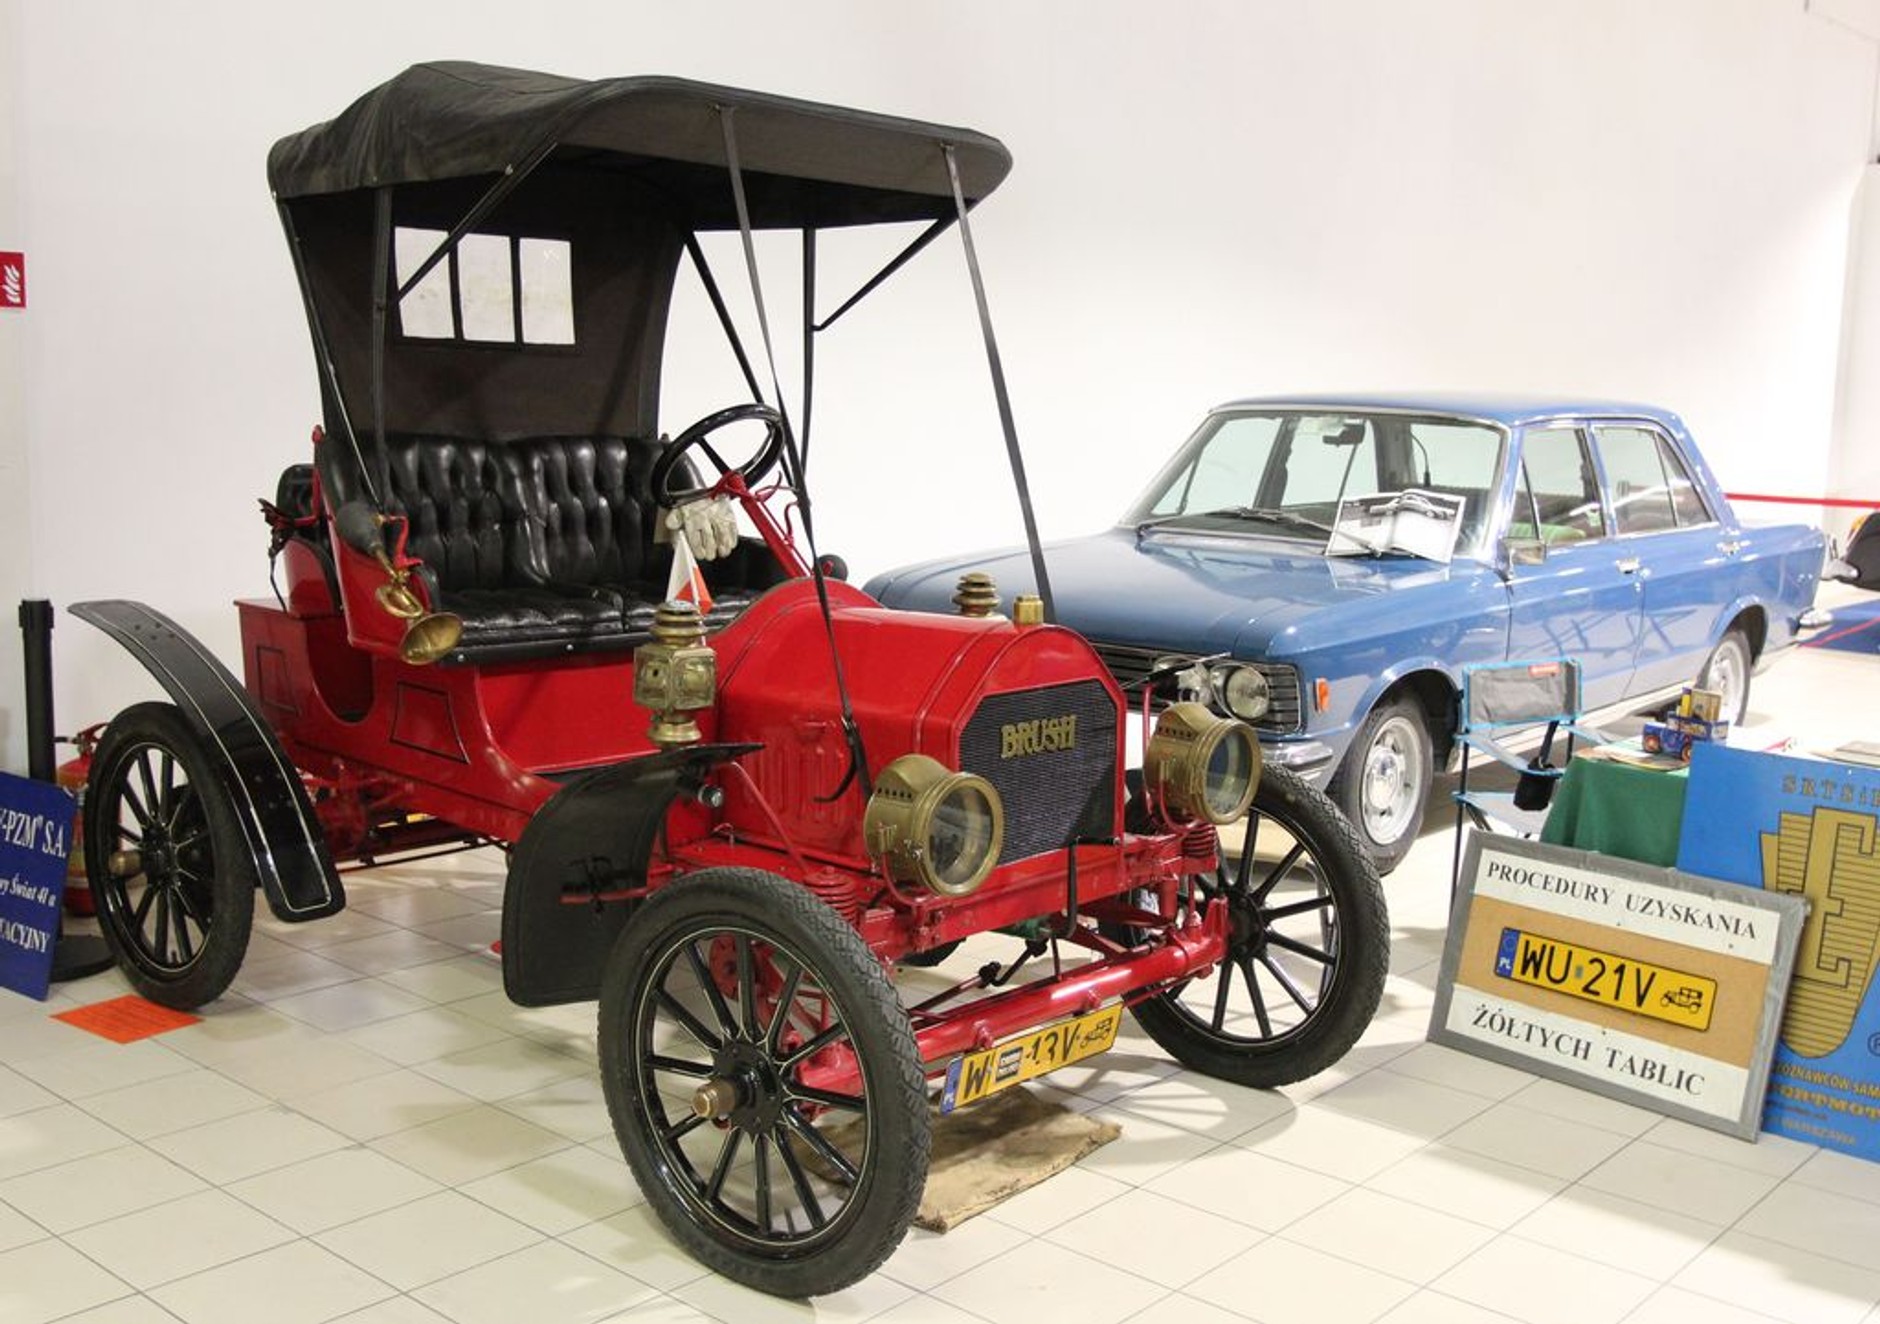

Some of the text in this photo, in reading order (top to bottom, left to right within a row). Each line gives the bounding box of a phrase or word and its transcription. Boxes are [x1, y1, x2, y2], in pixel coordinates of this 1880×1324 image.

[1001, 714, 1077, 758] BRUSH
[1487, 861, 1757, 940] PROCEDURY UZYSKANIA
[1520, 939, 1657, 1008] WU 21V
[1471, 1003, 1706, 1096] ŻÓŁTYCH TABLIC
